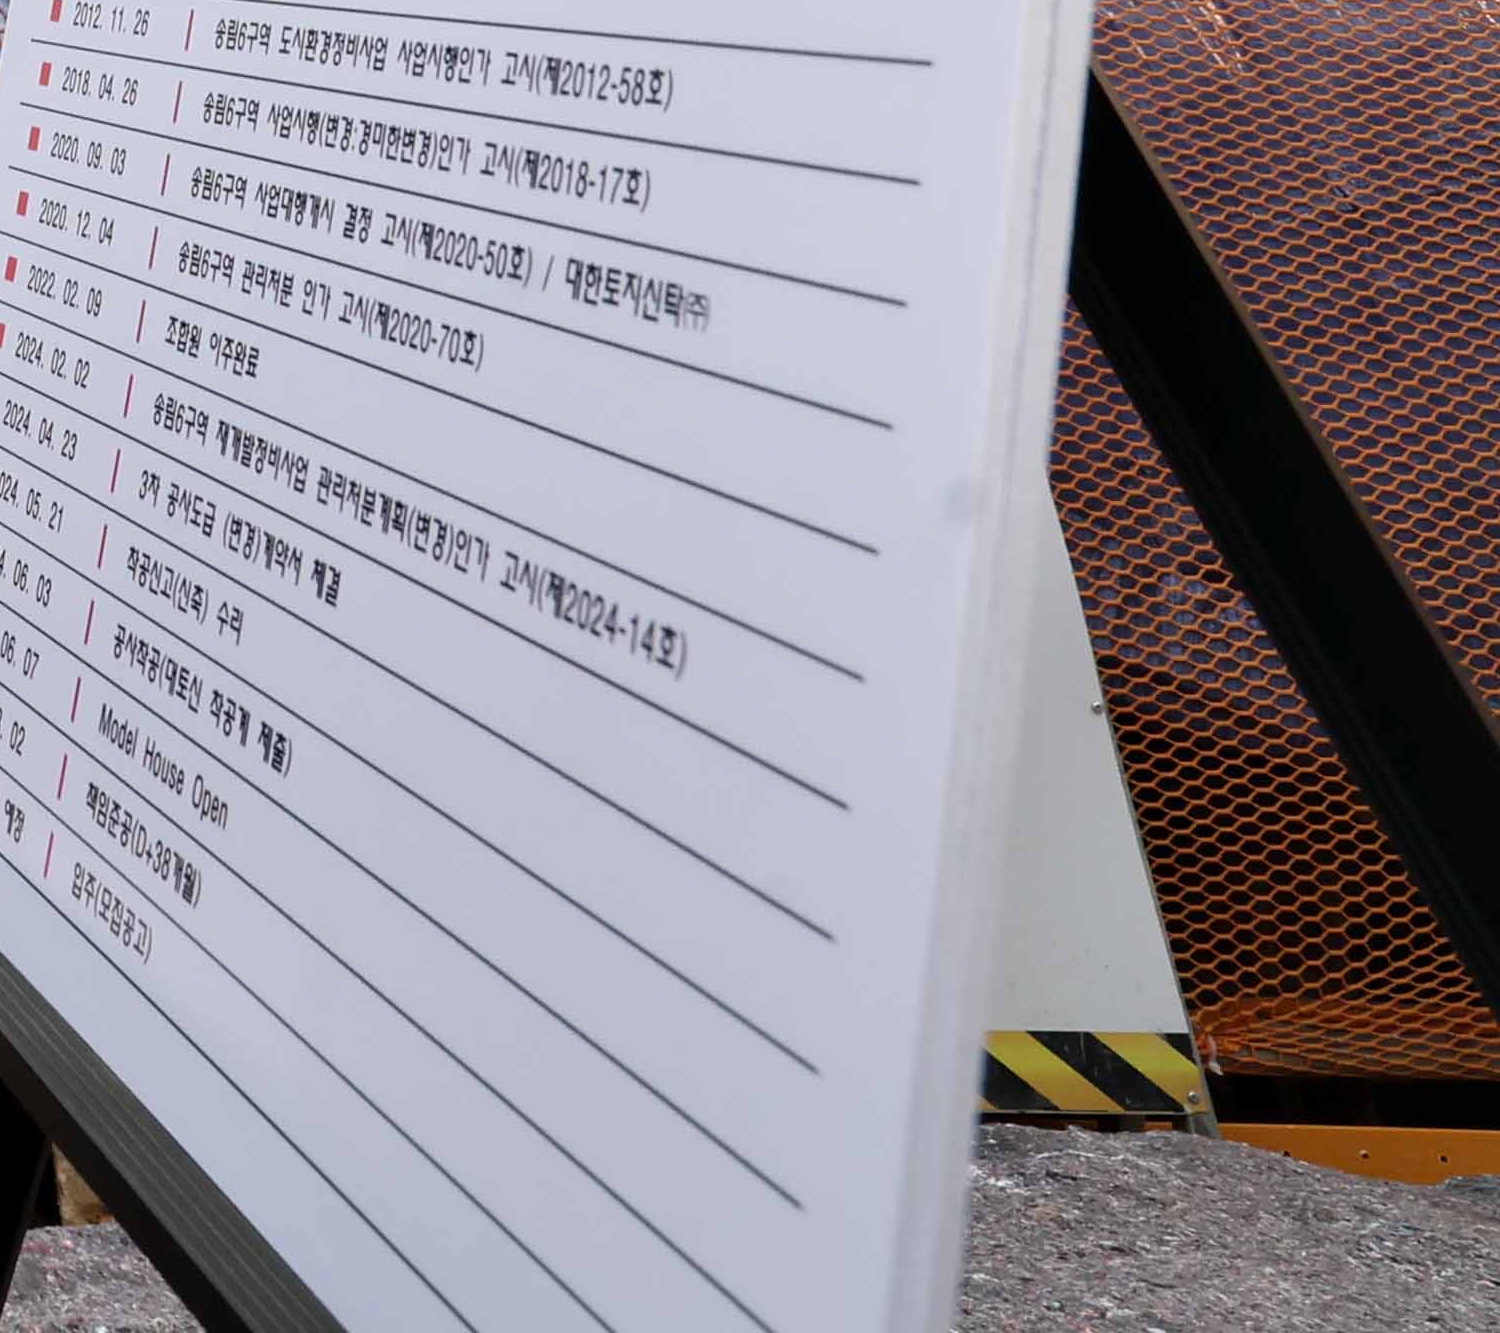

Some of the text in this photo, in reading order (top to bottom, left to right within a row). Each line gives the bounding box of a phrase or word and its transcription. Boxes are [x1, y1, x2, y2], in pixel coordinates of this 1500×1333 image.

[214, 17, 674, 113] 송림6구역 도시환경정비사업 사업시행인가 고시(제2012-58호)
[50, 131, 80, 164] 2020.
[86, 140, 103, 172] 09.
[110, 145, 127, 177] 03
[190, 165, 248, 209] 송림6구역
[254, 178, 335, 234] 사업대행개시
[342, 203, 372, 245] 결정
[380, 211, 534, 288] 고시(제2020-50호)
[203, 90, 260, 131] 송림6구역
[479, 141, 652, 213] 고시(제2018-17호)
[27, 264, 260, 380] 2022. 02. 09 조합원 이주완료
[178, 240, 485, 374] 송림6구역 관리처분 인가 고시(제2020-70호)
[26, 488, 43, 527] 05.
[48, 501, 64, 534] 21
[126, 544, 209, 626] 착공신고(신축)
[216, 601, 244, 646] 수리
[138, 470, 342, 608] 3차 공사도급 (변경)계약서 체결
[153, 392, 688, 682] 송림6구역 재개발정비사업 관리처분계획(변경)인가 고시(제2024-14호)
[98, 702, 229, 832] Model House Open
[209, 688, 251, 749] 착공계
[258, 720, 293, 779] 제출)
[4, 802, 25, 844] 예정
[71, 861, 153, 965] 입주(모집공고)
[85, 780, 203, 910] 책임준공(D+38개월)
